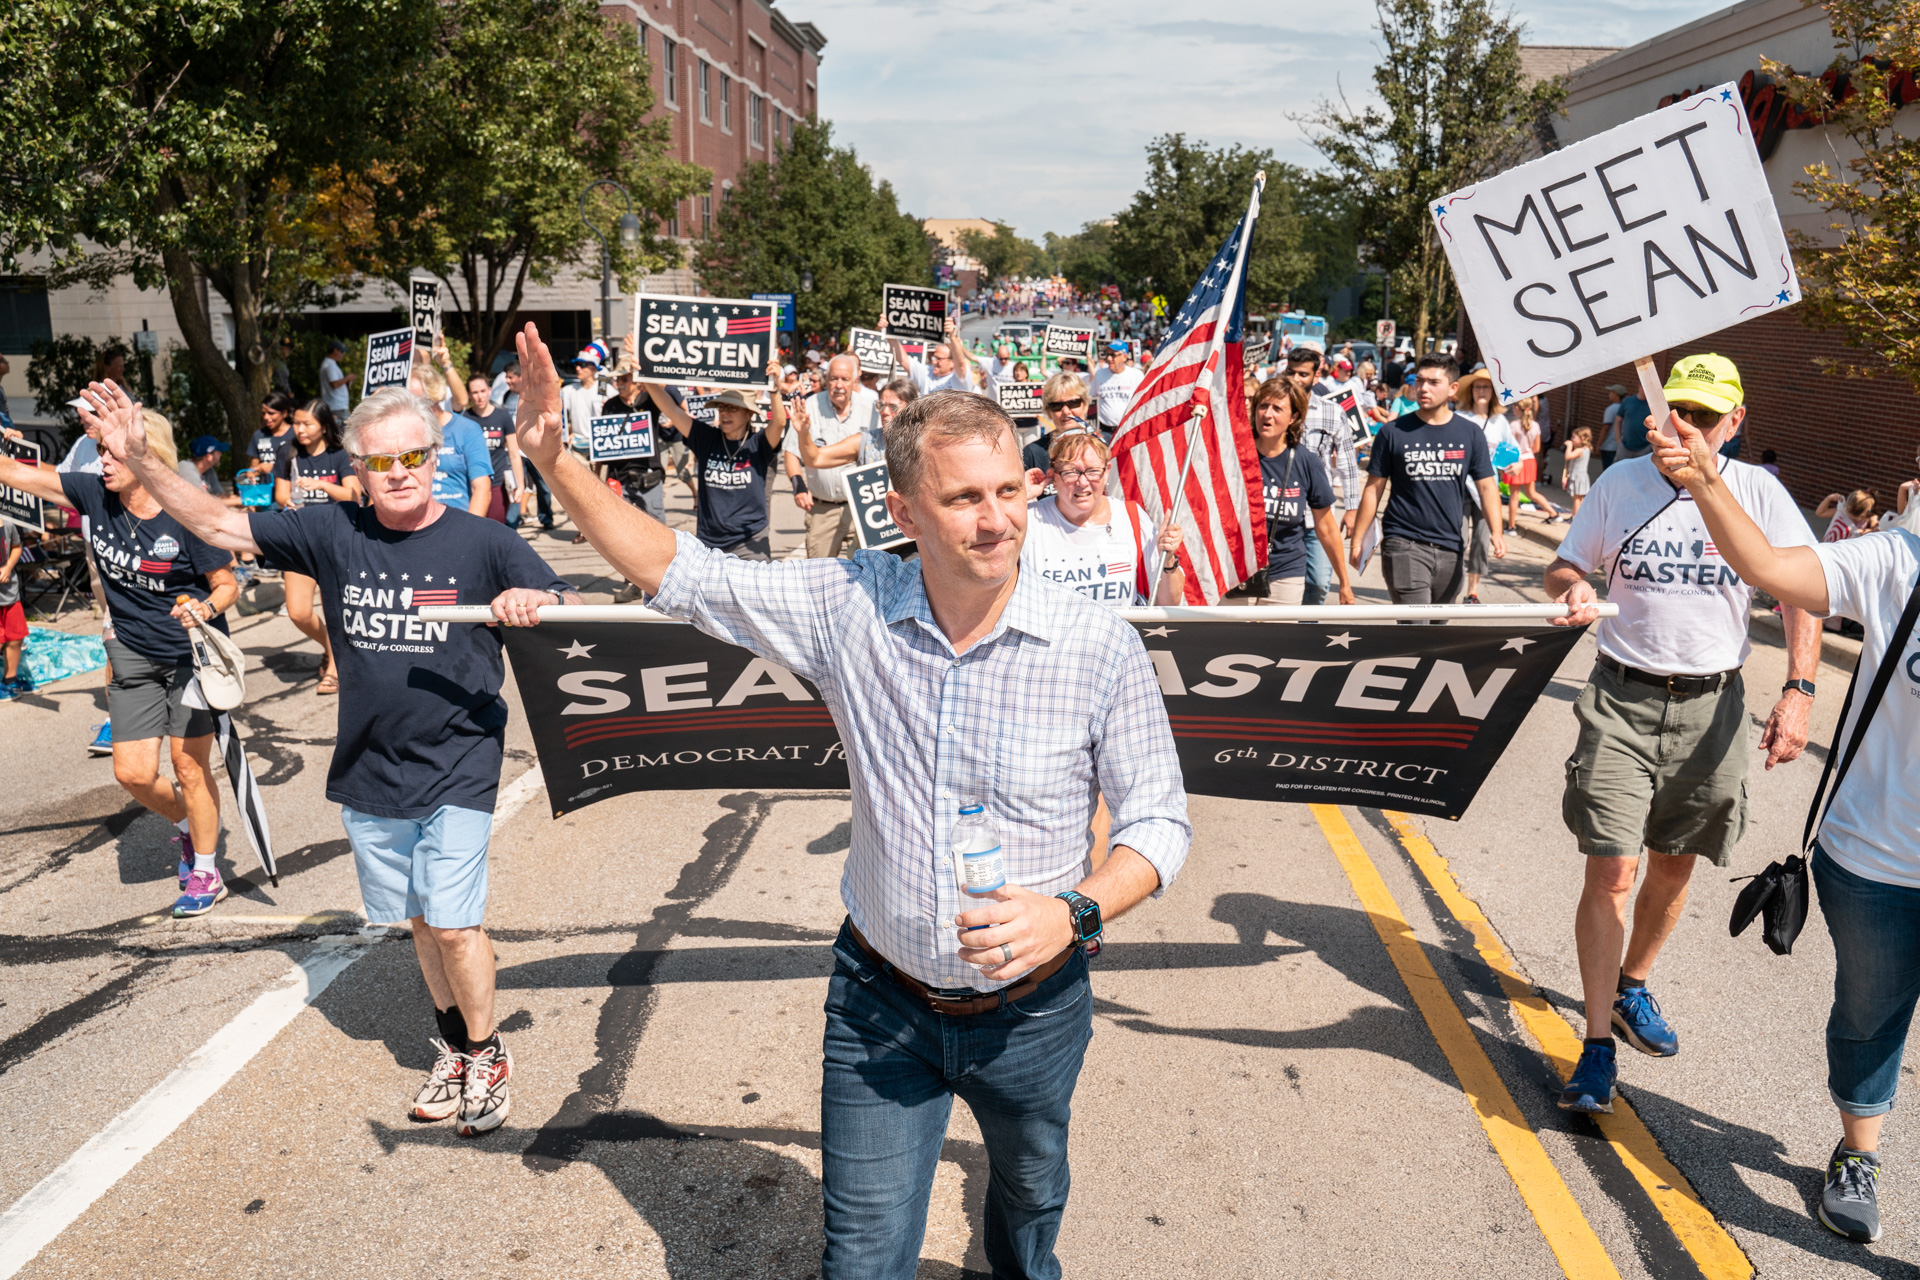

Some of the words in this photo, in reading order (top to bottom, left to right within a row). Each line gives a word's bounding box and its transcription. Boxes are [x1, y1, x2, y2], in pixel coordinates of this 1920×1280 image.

[1473, 121, 1710, 281] MEET
[1513, 208, 1758, 358] SEAN
[415, 294, 436, 311] SEA
[889, 297, 921, 311] SEAN
[646, 314, 709, 337] SEAN
[888, 310, 943, 332] CASTEN
[1050, 331, 1072, 341] SEAN
[644, 337, 760, 368] CASTEN
[856, 338, 891, 352] SEAN
[1048, 340, 1087, 352] CASTEN
[371, 345, 393, 363] SEAN
[855, 348, 894, 365] CAST
[369, 360, 410, 384] CASTEN
[653, 365, 697, 376] DEMOCRAT
[697, 368, 708, 377] for
[708, 370, 749, 379] CONGRESS
[1687, 373, 1714, 382] MARATHON
[1001, 390, 1026, 399] SEAN
[690, 408, 714, 418] CAST
[593, 433, 650, 451] CASTEN
[1404, 450, 1436, 462] SEAN
[704, 470, 752, 484] CASTEN
[1405, 461, 1463, 476] CASTEN
[859, 480, 888, 504] SE
[92, 534, 131, 567] SEAN
[153, 546, 179, 554] CASTEN
[1619, 559, 1740, 586] CASTEN
[343, 584, 395, 609] SEAN
[1624, 583, 1667, 594] DEMOCRAT
[1681, 588, 1724, 596] CONGRESS
[342, 609, 450, 642] CASTEN
[377, 643, 389, 653] for
[390, 644, 435, 653] CONGRESS
[557, 657, 815, 715] SEA
[1147, 649, 1517, 720] ASTEN
[580, 744, 809, 779] DEMOCRAT
[815, 741, 848, 766] fo
[1213, 747, 1258, 764] 6th
[1267, 753, 1448, 785] DISTRICT
[1351, 788, 1386, 796] CONGRESS.
[1387, 792, 1413, 801] PRINTED
